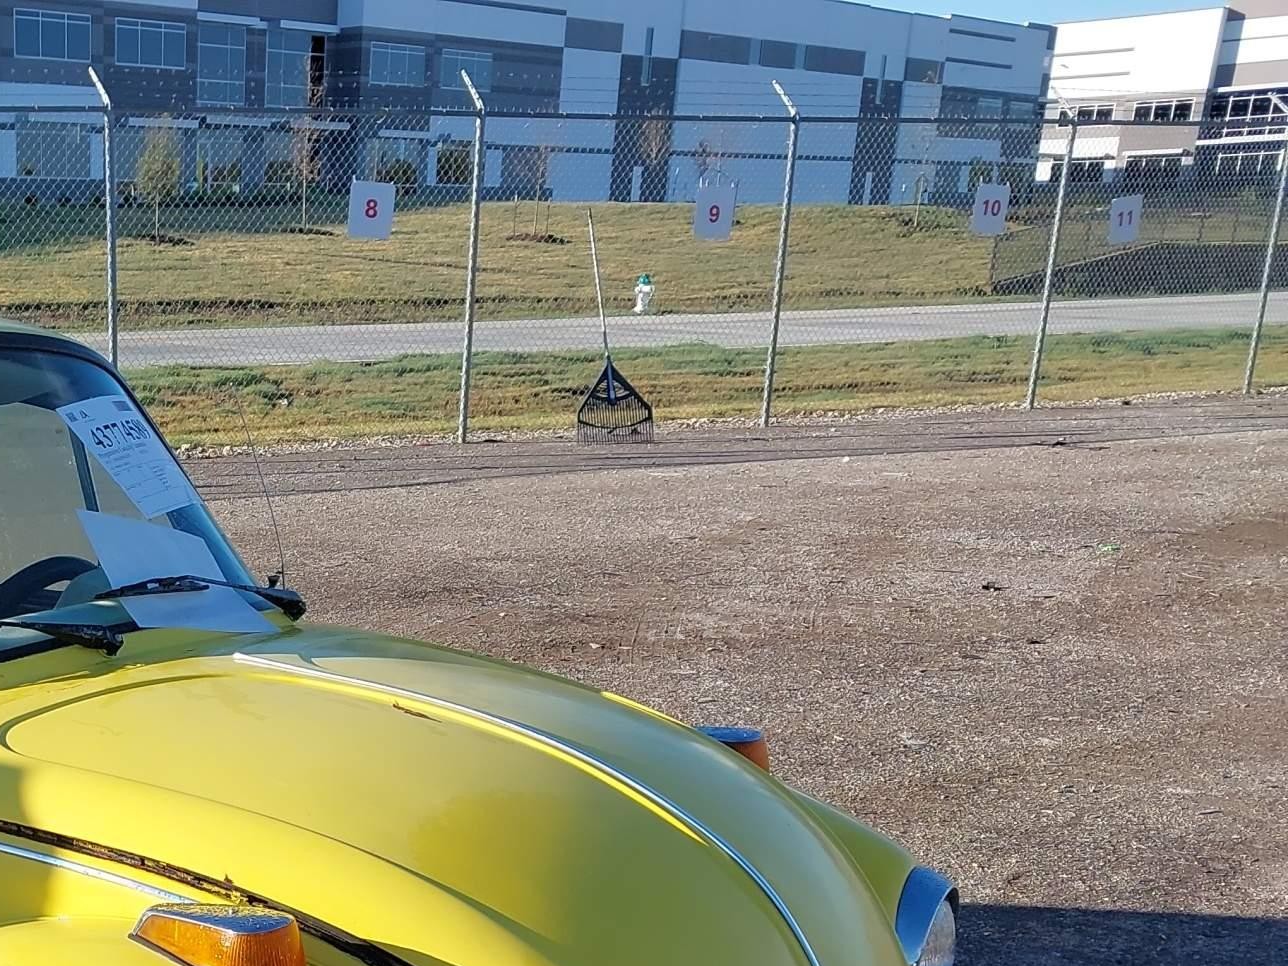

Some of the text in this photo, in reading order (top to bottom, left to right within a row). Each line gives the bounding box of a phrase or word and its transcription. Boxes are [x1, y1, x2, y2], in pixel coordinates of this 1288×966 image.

[364, 198, 378, 219] 8
[708, 204, 721, 223] 9
[982, 199, 1002, 217] 10
[1117, 209, 1134, 227] 11
